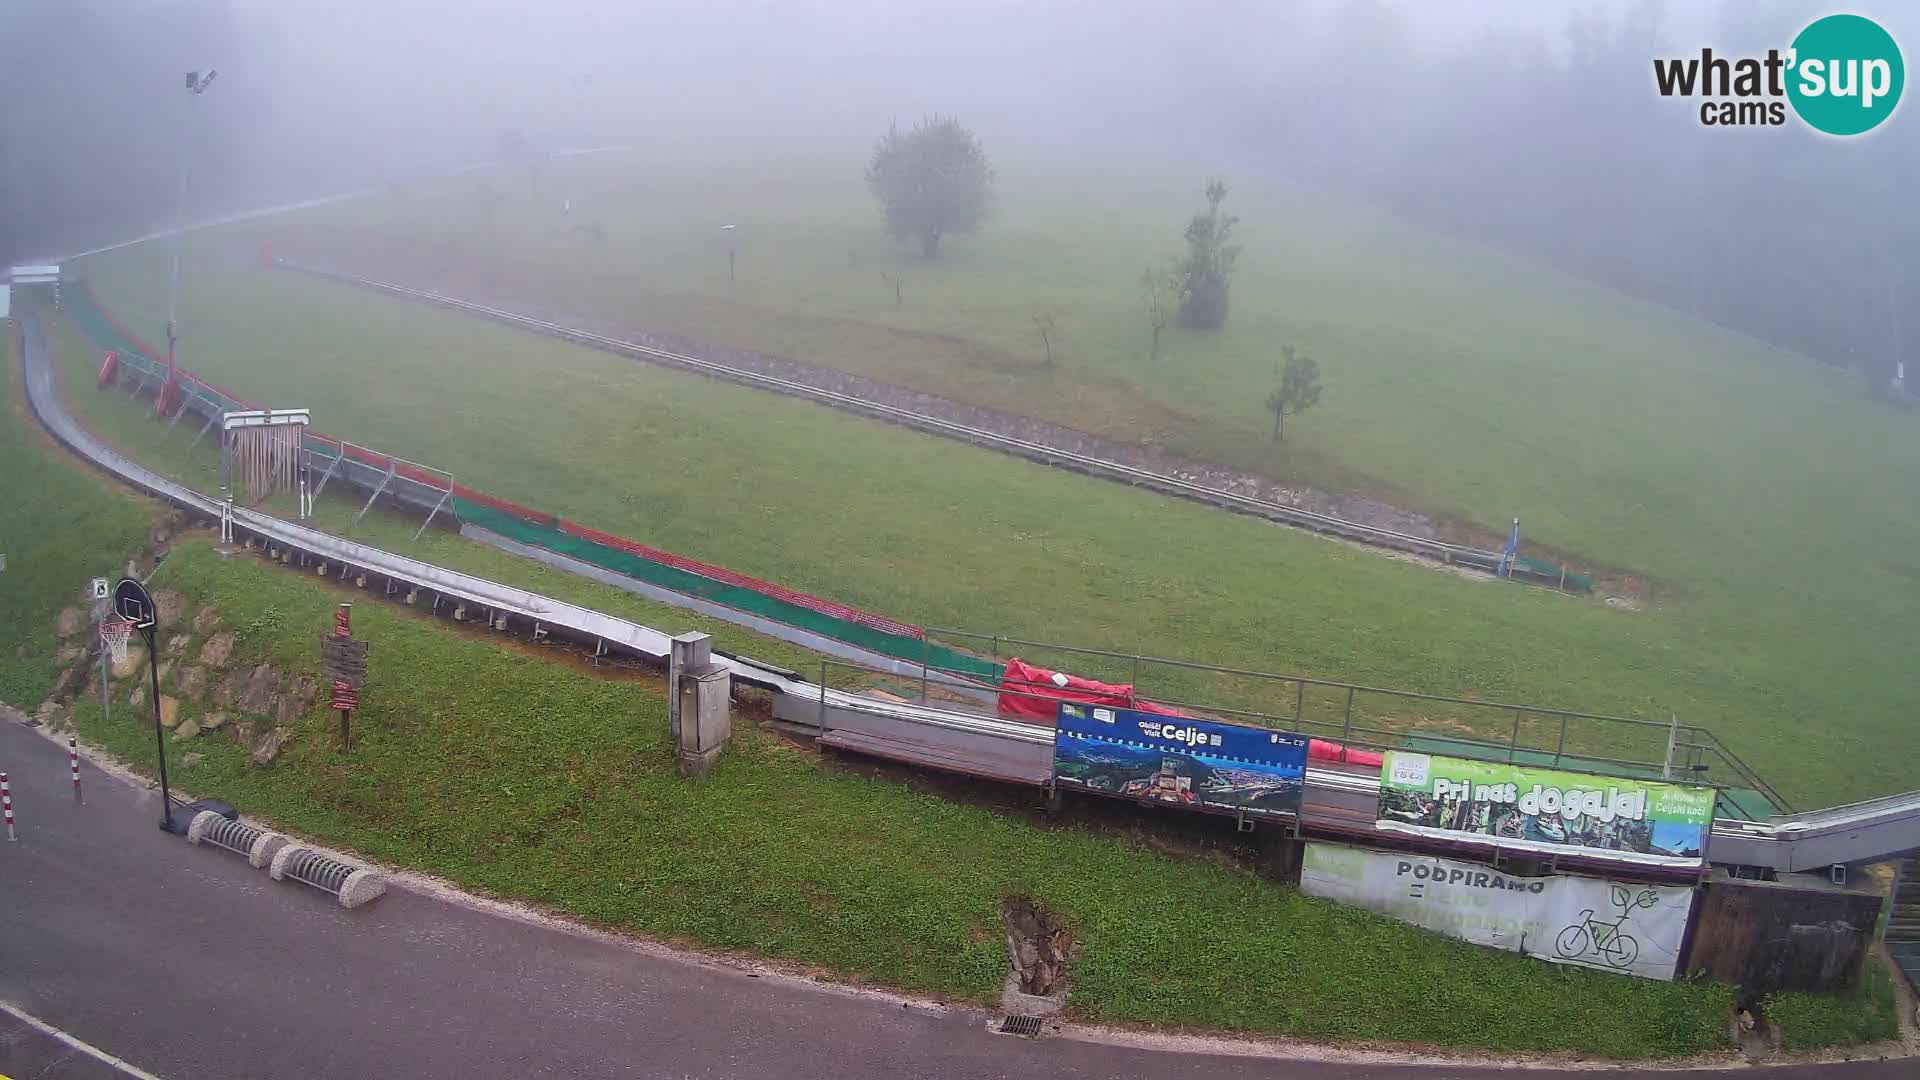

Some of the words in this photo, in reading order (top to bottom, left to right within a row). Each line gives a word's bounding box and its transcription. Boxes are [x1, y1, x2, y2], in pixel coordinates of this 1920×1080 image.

[1144, 729, 1162, 738] Visit
[1162, 724, 1208, 747] Celje
[1433, 777, 1470, 801] Pri
[1396, 860, 1545, 894] PODPIRAMO
